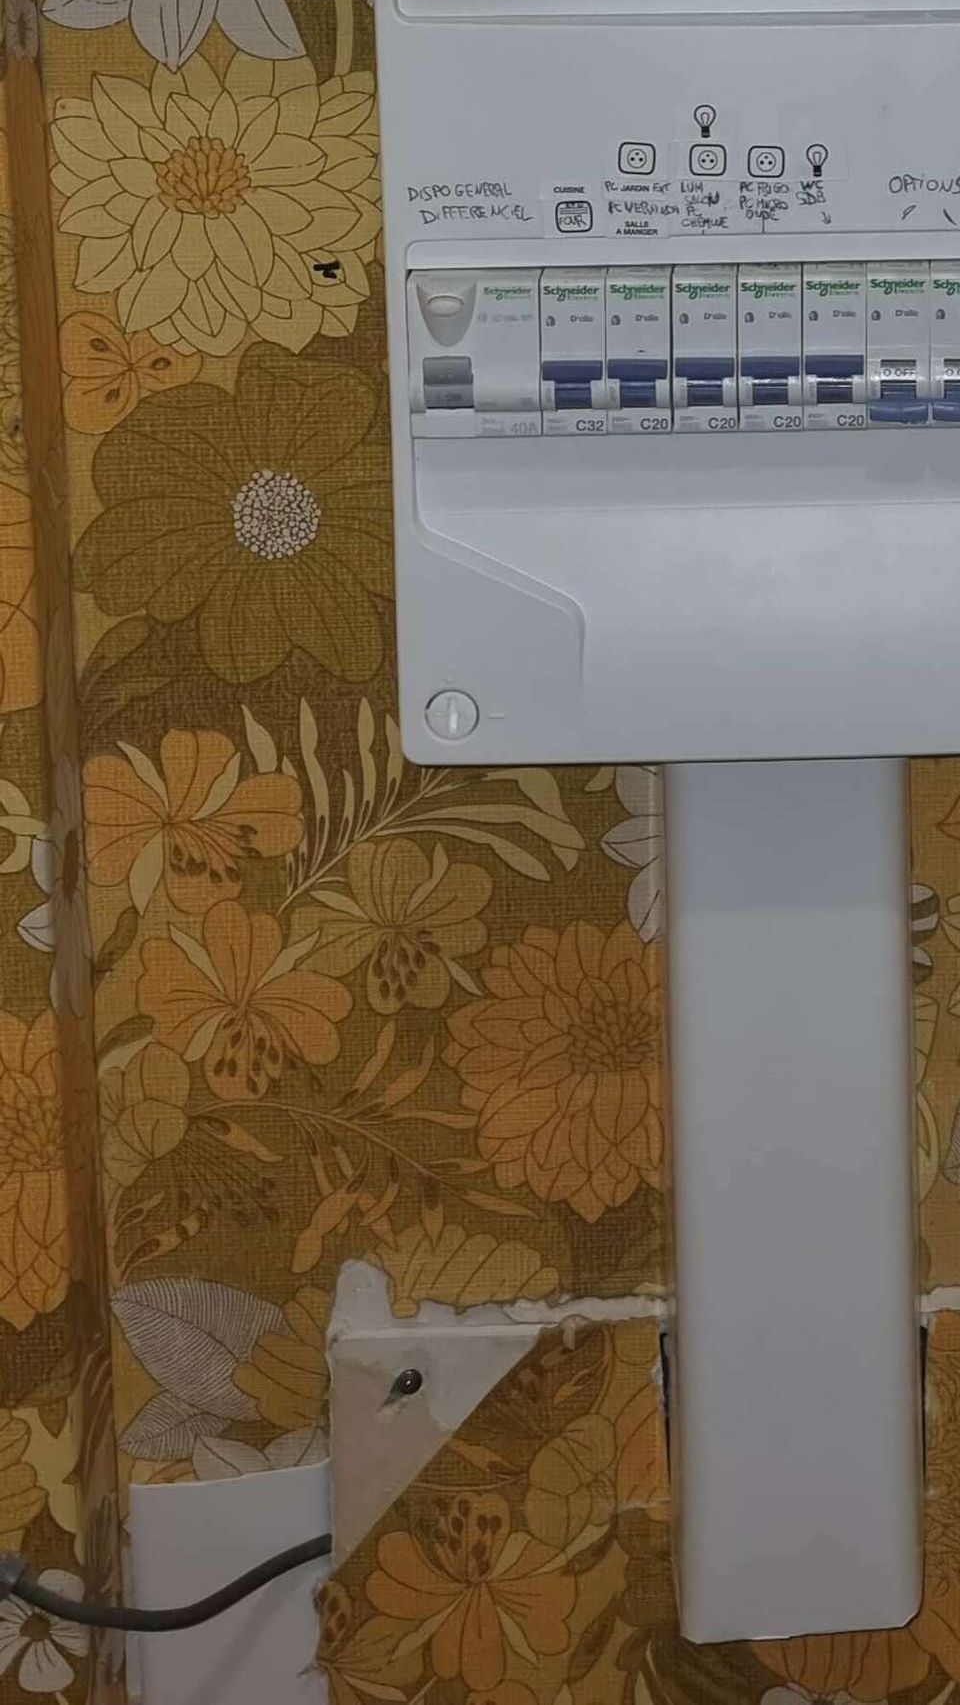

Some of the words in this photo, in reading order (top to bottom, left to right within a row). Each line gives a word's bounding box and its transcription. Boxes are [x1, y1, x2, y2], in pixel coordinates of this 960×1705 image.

[543, 285, 600, 301] Schneider
[610, 284, 666, 300] Schneider
[675, 283, 731, 300] Schneider
[741, 282, 796, 298] Schneider
[806, 280, 861, 296] Schneider
[870, 278, 926, 295] Schneider
[575, 420, 605, 432] C32
[640, 418, 669, 431] C20
[708, 417, 736, 430] C20
[773, 416, 801, 428] C20
[837, 414, 864, 427] C20
[510, 422, 538, 434] 40A
